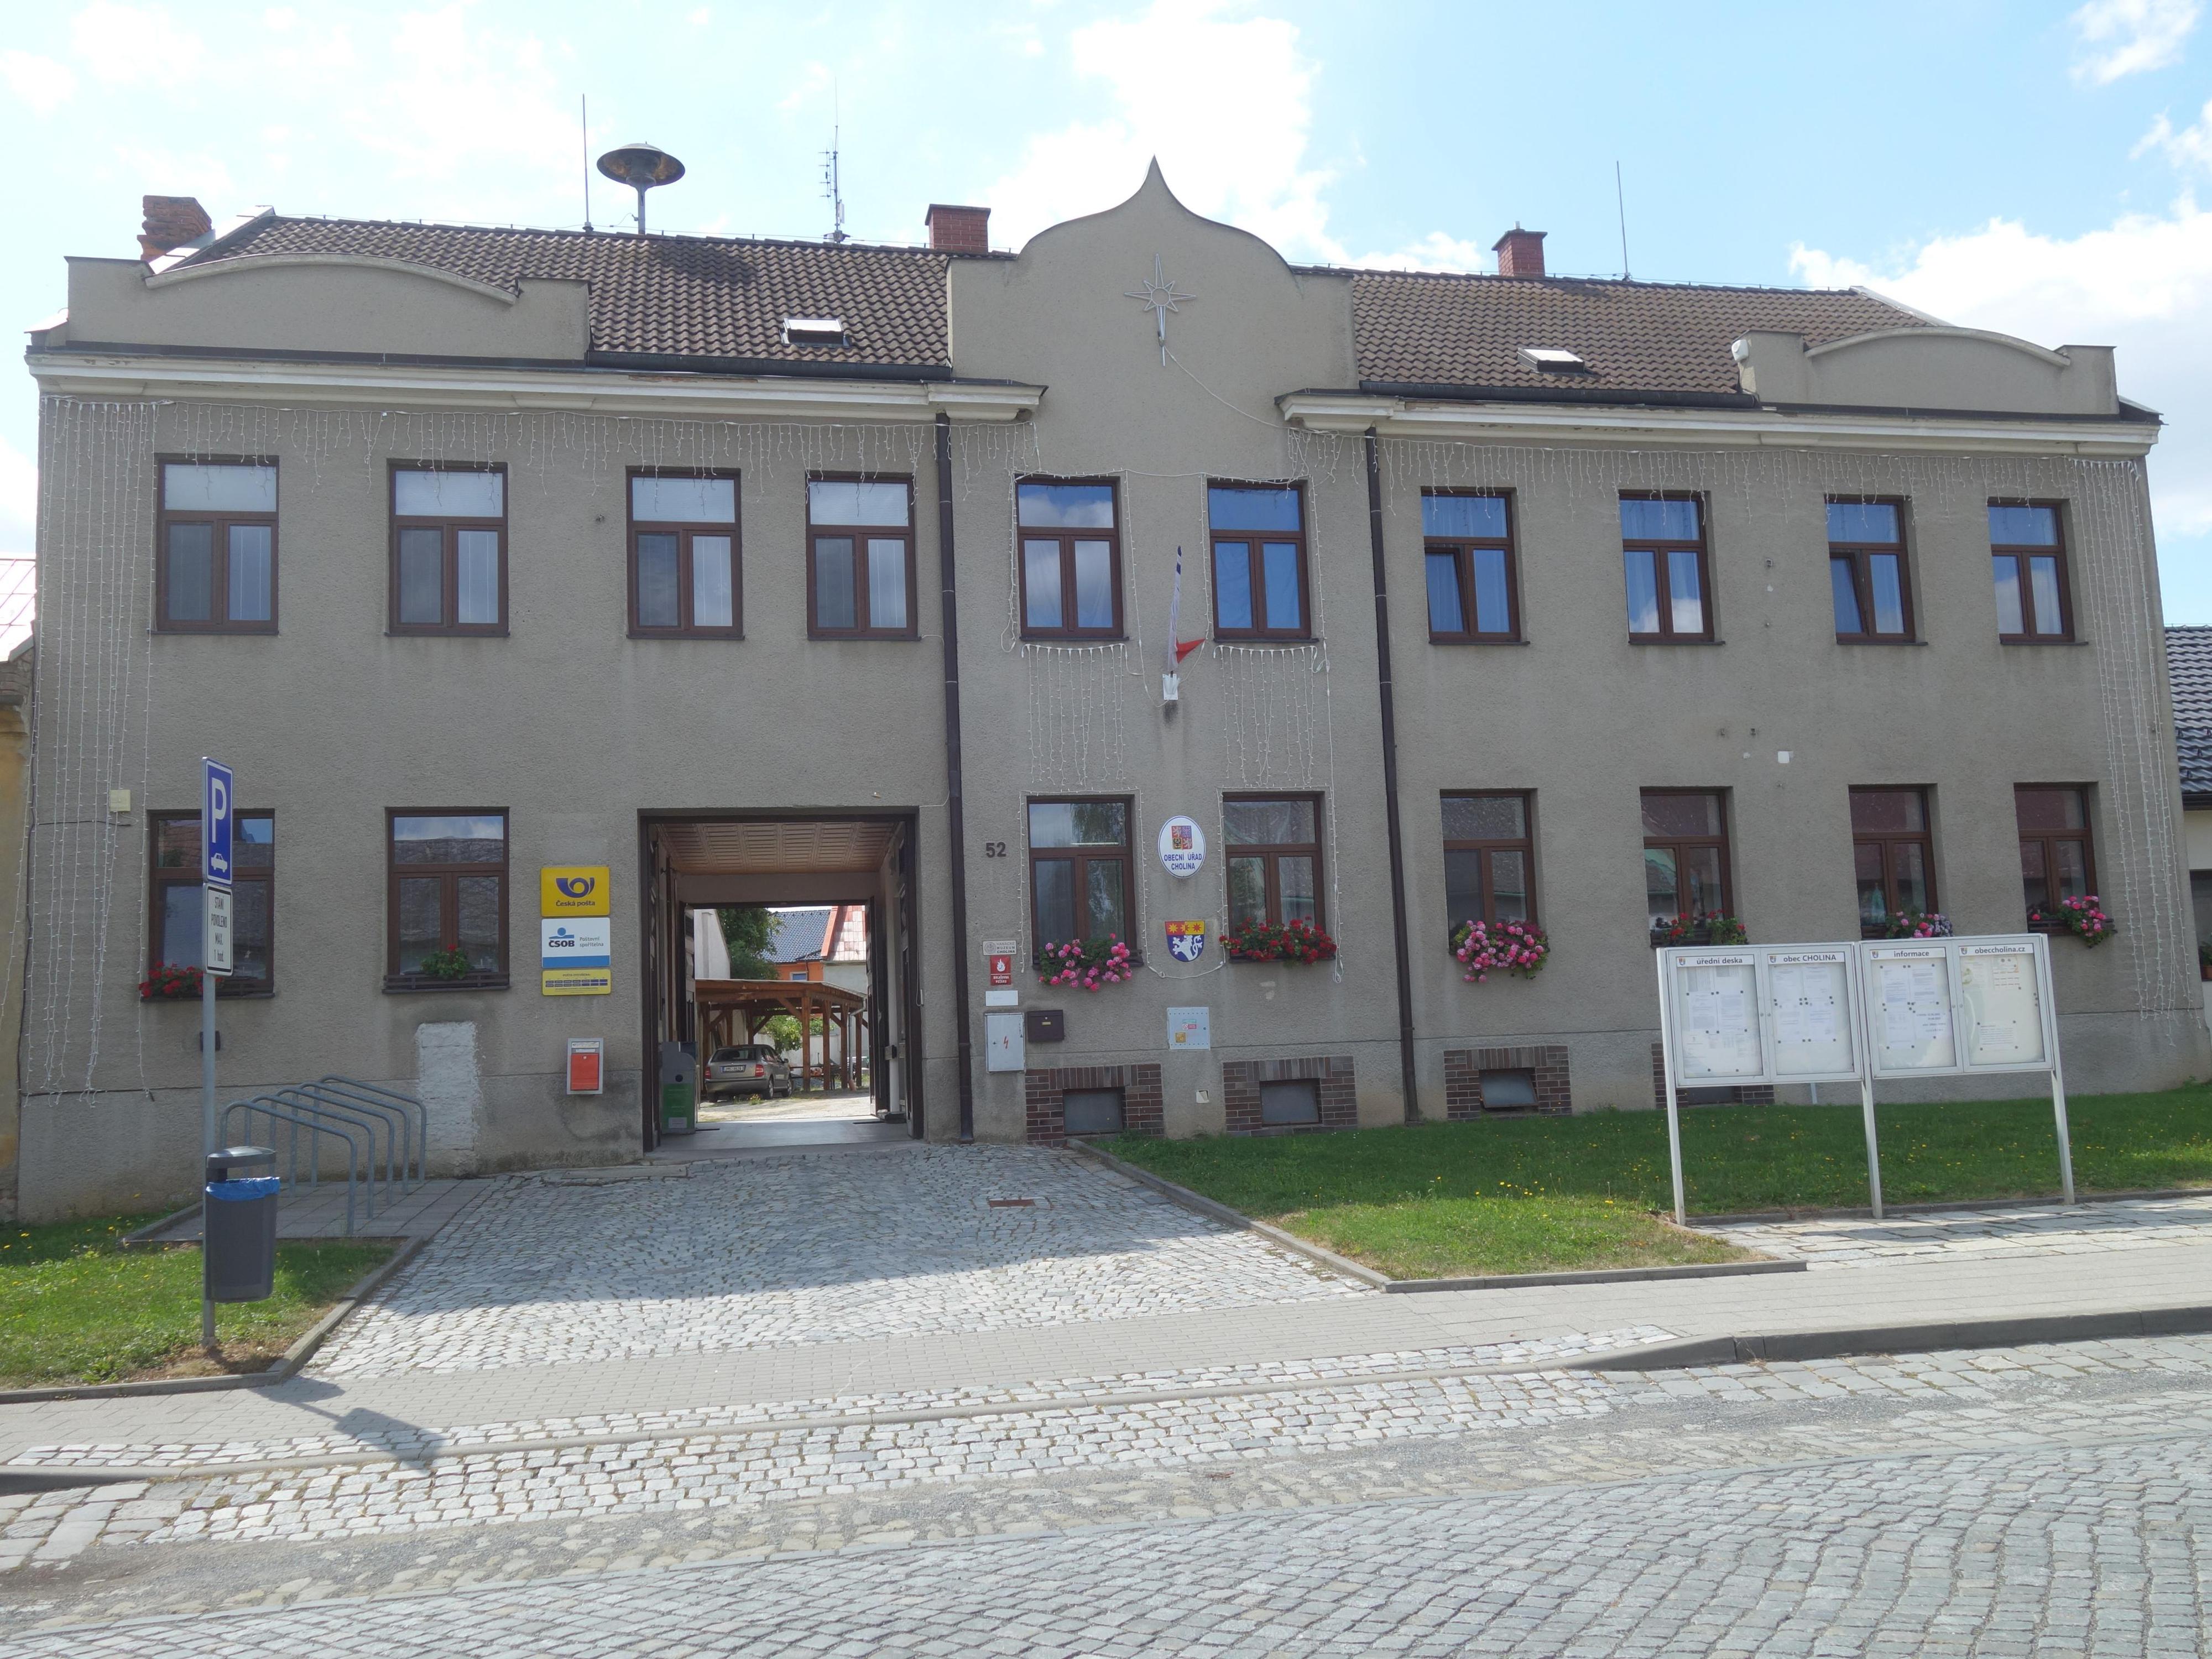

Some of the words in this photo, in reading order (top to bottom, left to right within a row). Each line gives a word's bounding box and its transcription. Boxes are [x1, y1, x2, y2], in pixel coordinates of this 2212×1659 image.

[212, 777, 227, 843] P
[986, 842, 1006, 858] 52
[1164, 852, 1185, 861] OBECNÍ
[1188, 852, 1202, 860] ÚŘAD
[215, 895, 224, 910] STÁNÍ
[211, 914, 227, 928] POVOLENO
[549, 940, 575, 948] ČSOB
